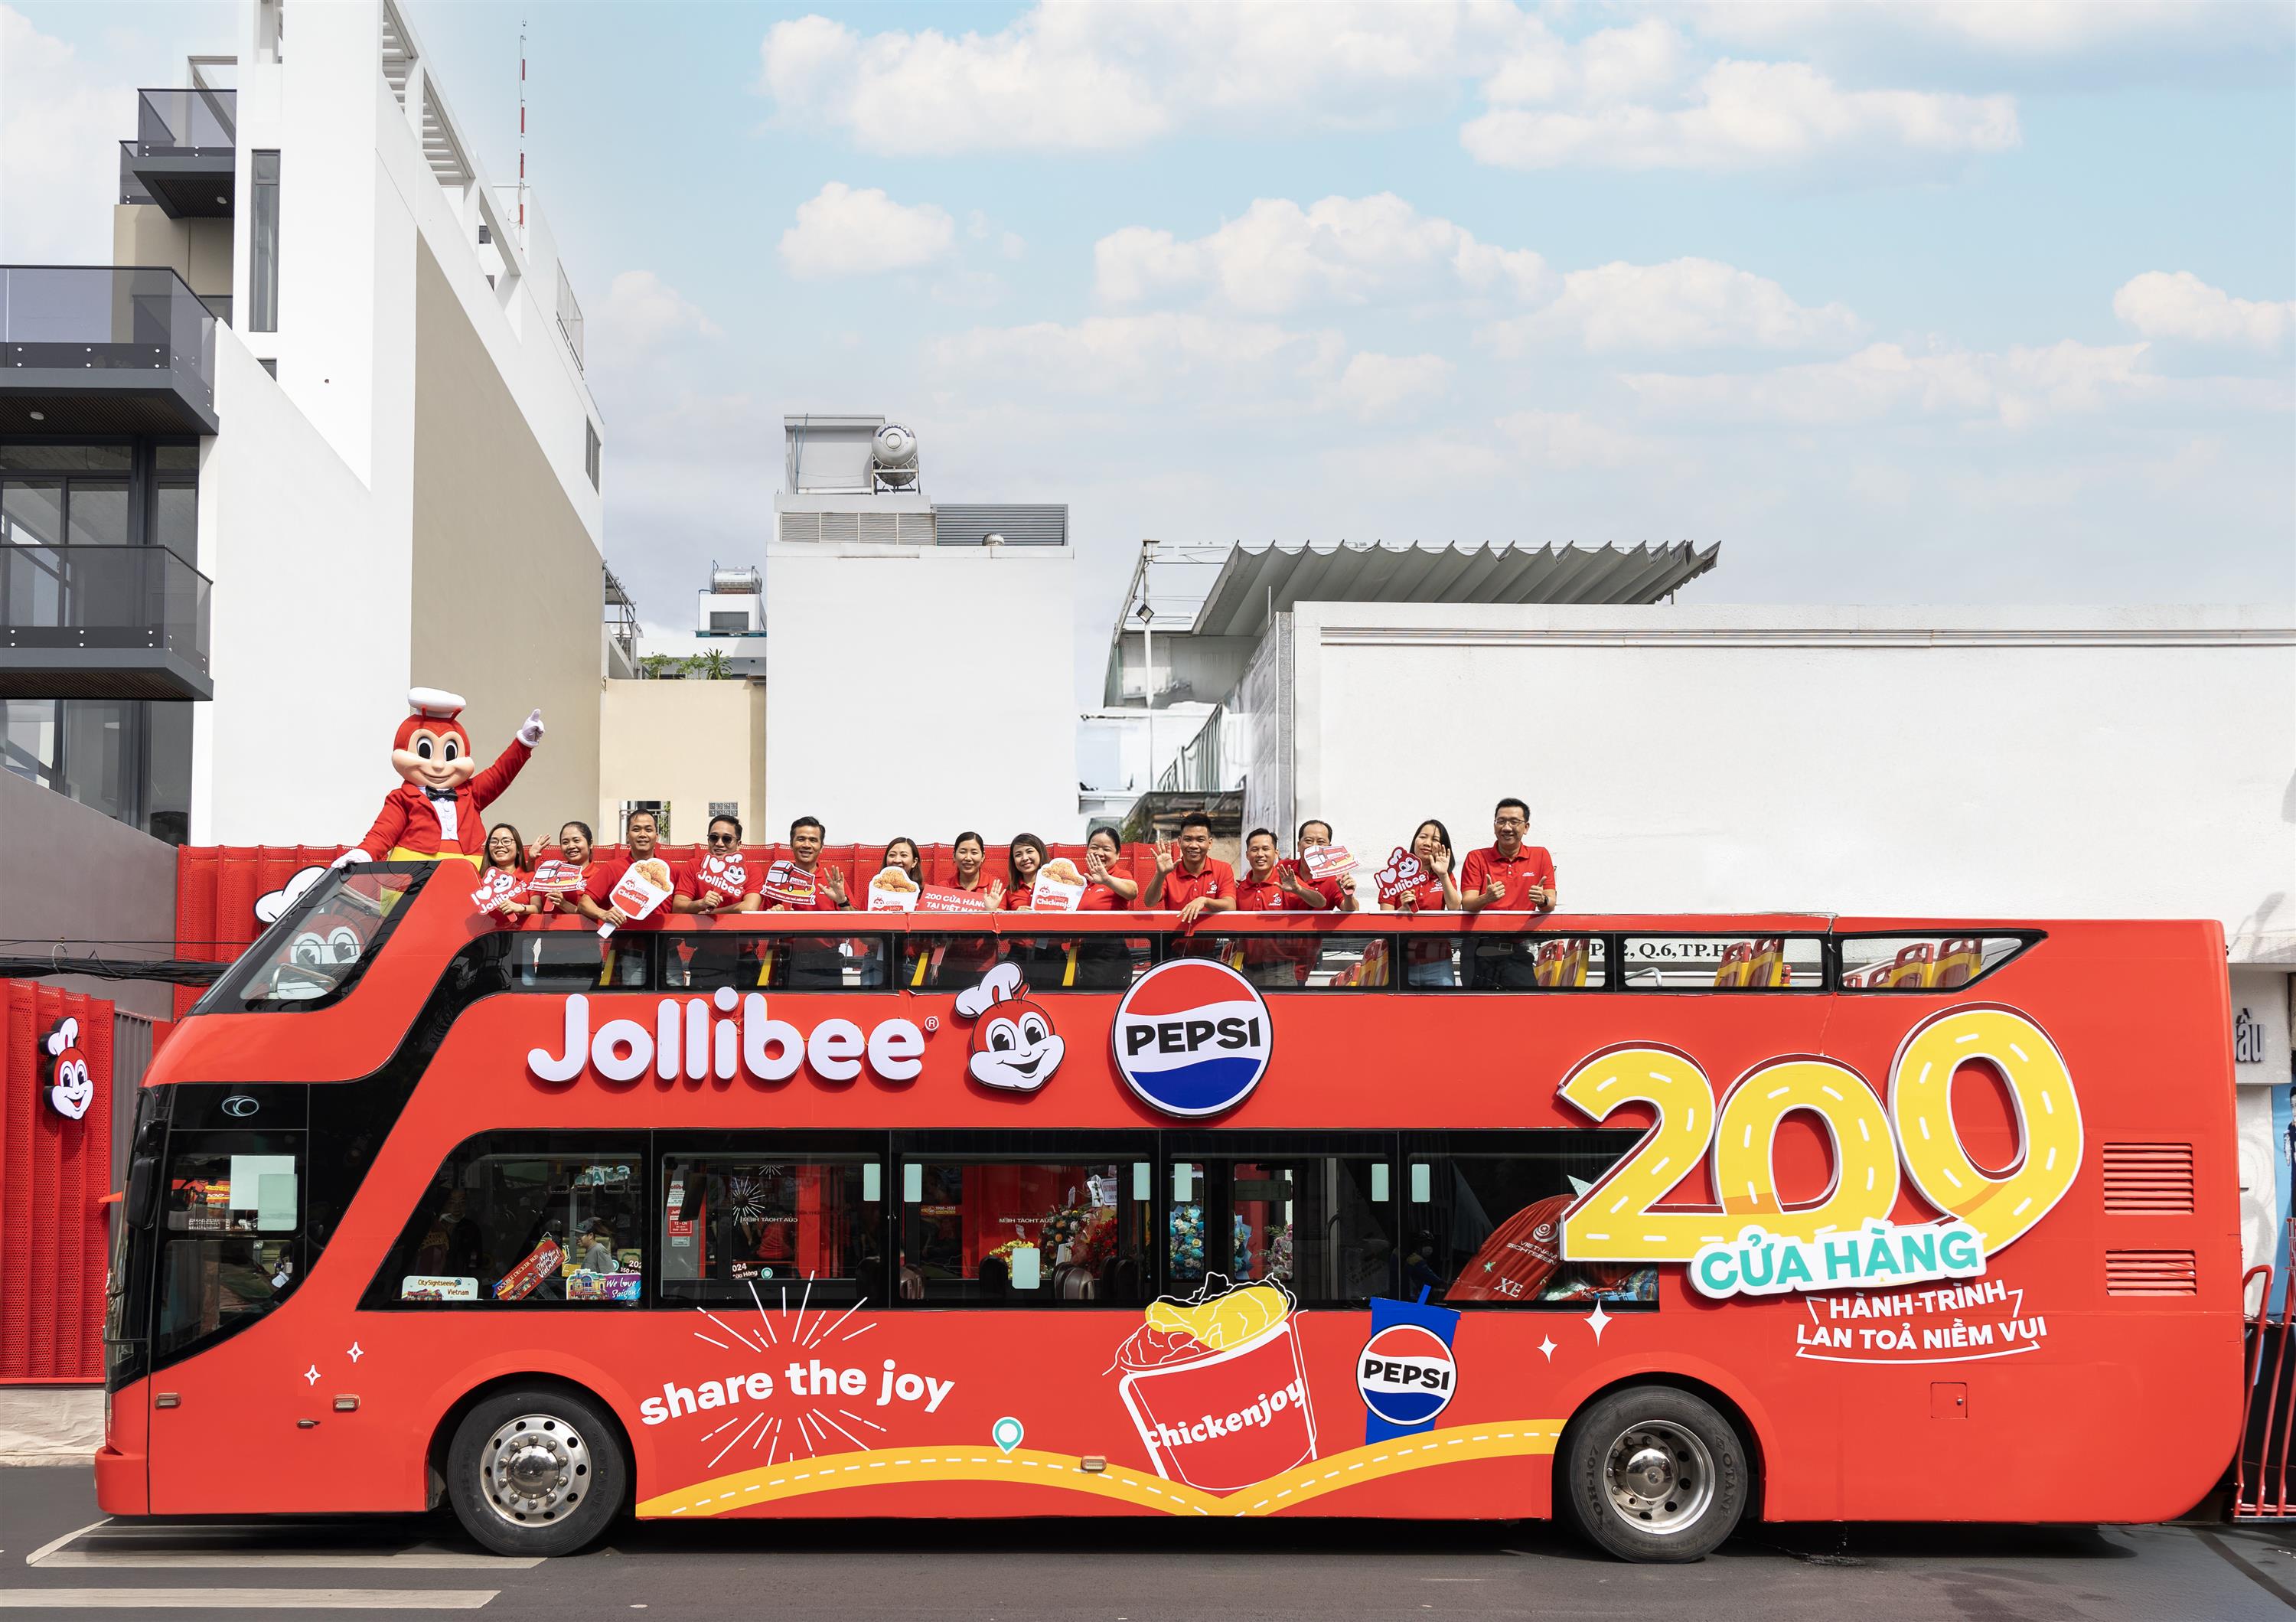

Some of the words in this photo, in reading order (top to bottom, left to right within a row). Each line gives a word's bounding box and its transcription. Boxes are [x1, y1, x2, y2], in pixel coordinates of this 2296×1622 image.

[700, 854, 711, 870] I
[697, 870, 742, 897] Jollibee
[1374, 873, 1383, 889] I
[1382, 874, 1427, 899] Jollibee
[470, 893, 481, 906] I
[479, 886, 523, 914] Jollibee
[1639, 942, 1677, 959] Q.6,
[1126, 1017, 1261, 1056] PEPSI
[2235, 1007, 2266, 1063] ầu
[1557, 1001, 2084, 1261] 200
[530, 1254, 539, 1263] BUS
[1506, 1242, 1557, 1266] SIGHTSEEIN
[1520, 1240, 1558, 1260] VIETNAM
[1700, 1233, 1813, 1291] CỬA
[1825, 1227, 1978, 1280] HÀNG
[606, 1278, 618, 1287] We
[612, 1285, 641, 1300] Saigon!
[1494, 1277, 1524, 1298] XE
[1796, 1323, 1856, 1348] LAN
[1858, 1322, 1918, 1349] TOẢ
[1923, 1317, 1994, 1349] NIỀM
[1998, 1316, 2048, 1343] VUI
[1363, 1359, 1451, 1392] PEPSI
[639, 1369, 774, 1425] share
[784, 1359, 867, 1396] the
[876, 1359, 956, 1413] joy
